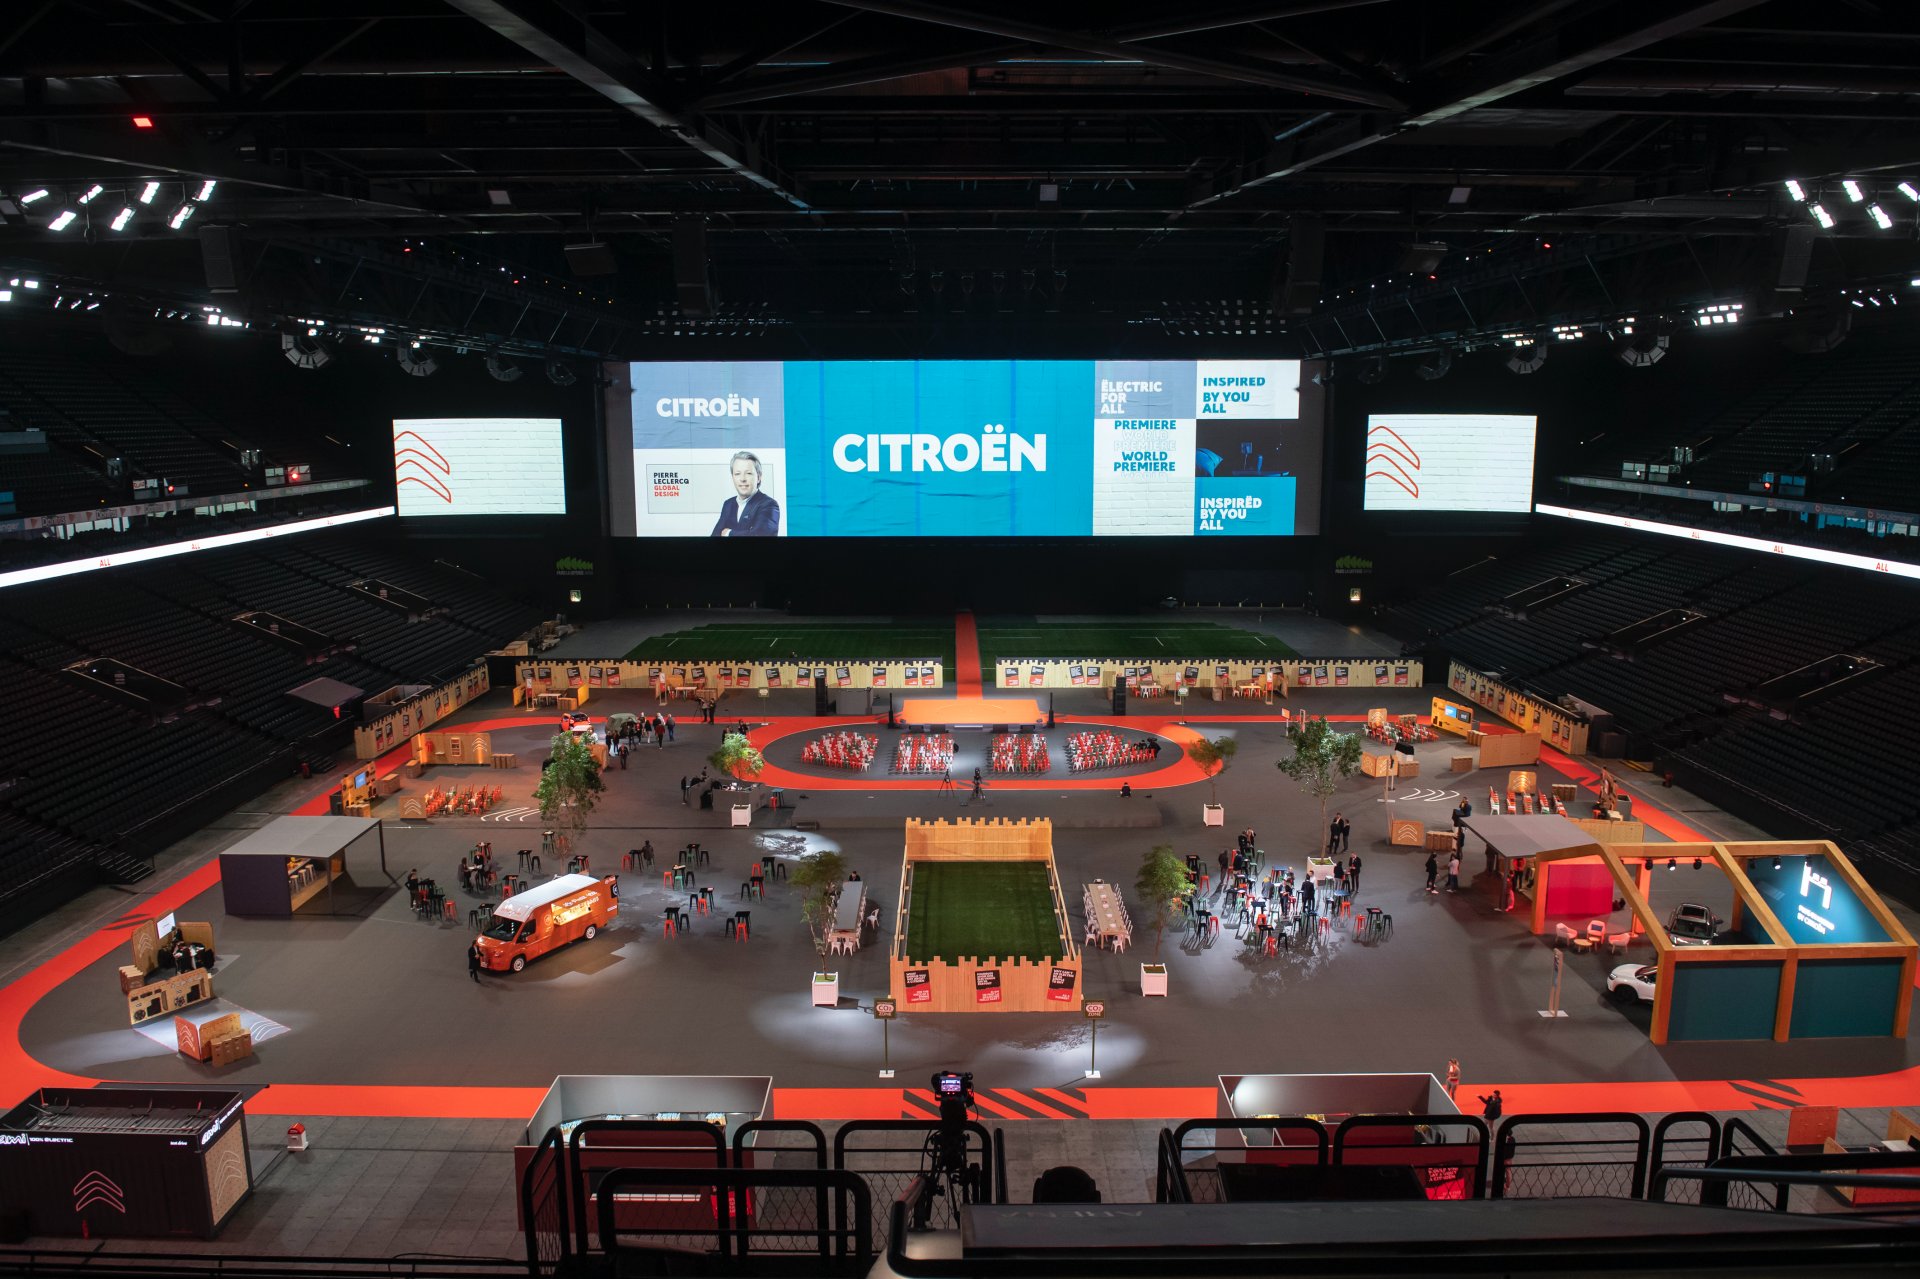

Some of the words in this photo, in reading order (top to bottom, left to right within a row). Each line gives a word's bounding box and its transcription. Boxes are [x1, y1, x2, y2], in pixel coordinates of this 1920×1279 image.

[1101, 379, 1162, 393] ËLECTRIC
[1203, 377, 1265, 386] INSPIRED
[1101, 393, 1127, 403] FOR
[1203, 392, 1219, 402] BY
[1223, 392, 1250, 402] YOU
[656, 393, 759, 417] CITROËN
[1100, 404, 1124, 414] ALL
[1202, 404, 1226, 413] ALL
[1114, 420, 1176, 430] PREMIERE
[1121, 430, 1168, 441] WORLD
[832, 424, 1047, 473] CITROËN
[1113, 441, 1176, 451] PREMIERE
[1122, 451, 1168, 461] WORLD
[1113, 462, 1176, 471] PREMIERE
[1200, 496, 1262, 508] INSPIRËD
[1200, 509, 1219, 519] BY
[1219, 509, 1247, 519] YOU
[1200, 520, 1224, 530] ALL
[1774, 545, 1784, 553] ALL
[100, 559, 111, 567] ALL
[1876, 562, 1889, 571] ALL
